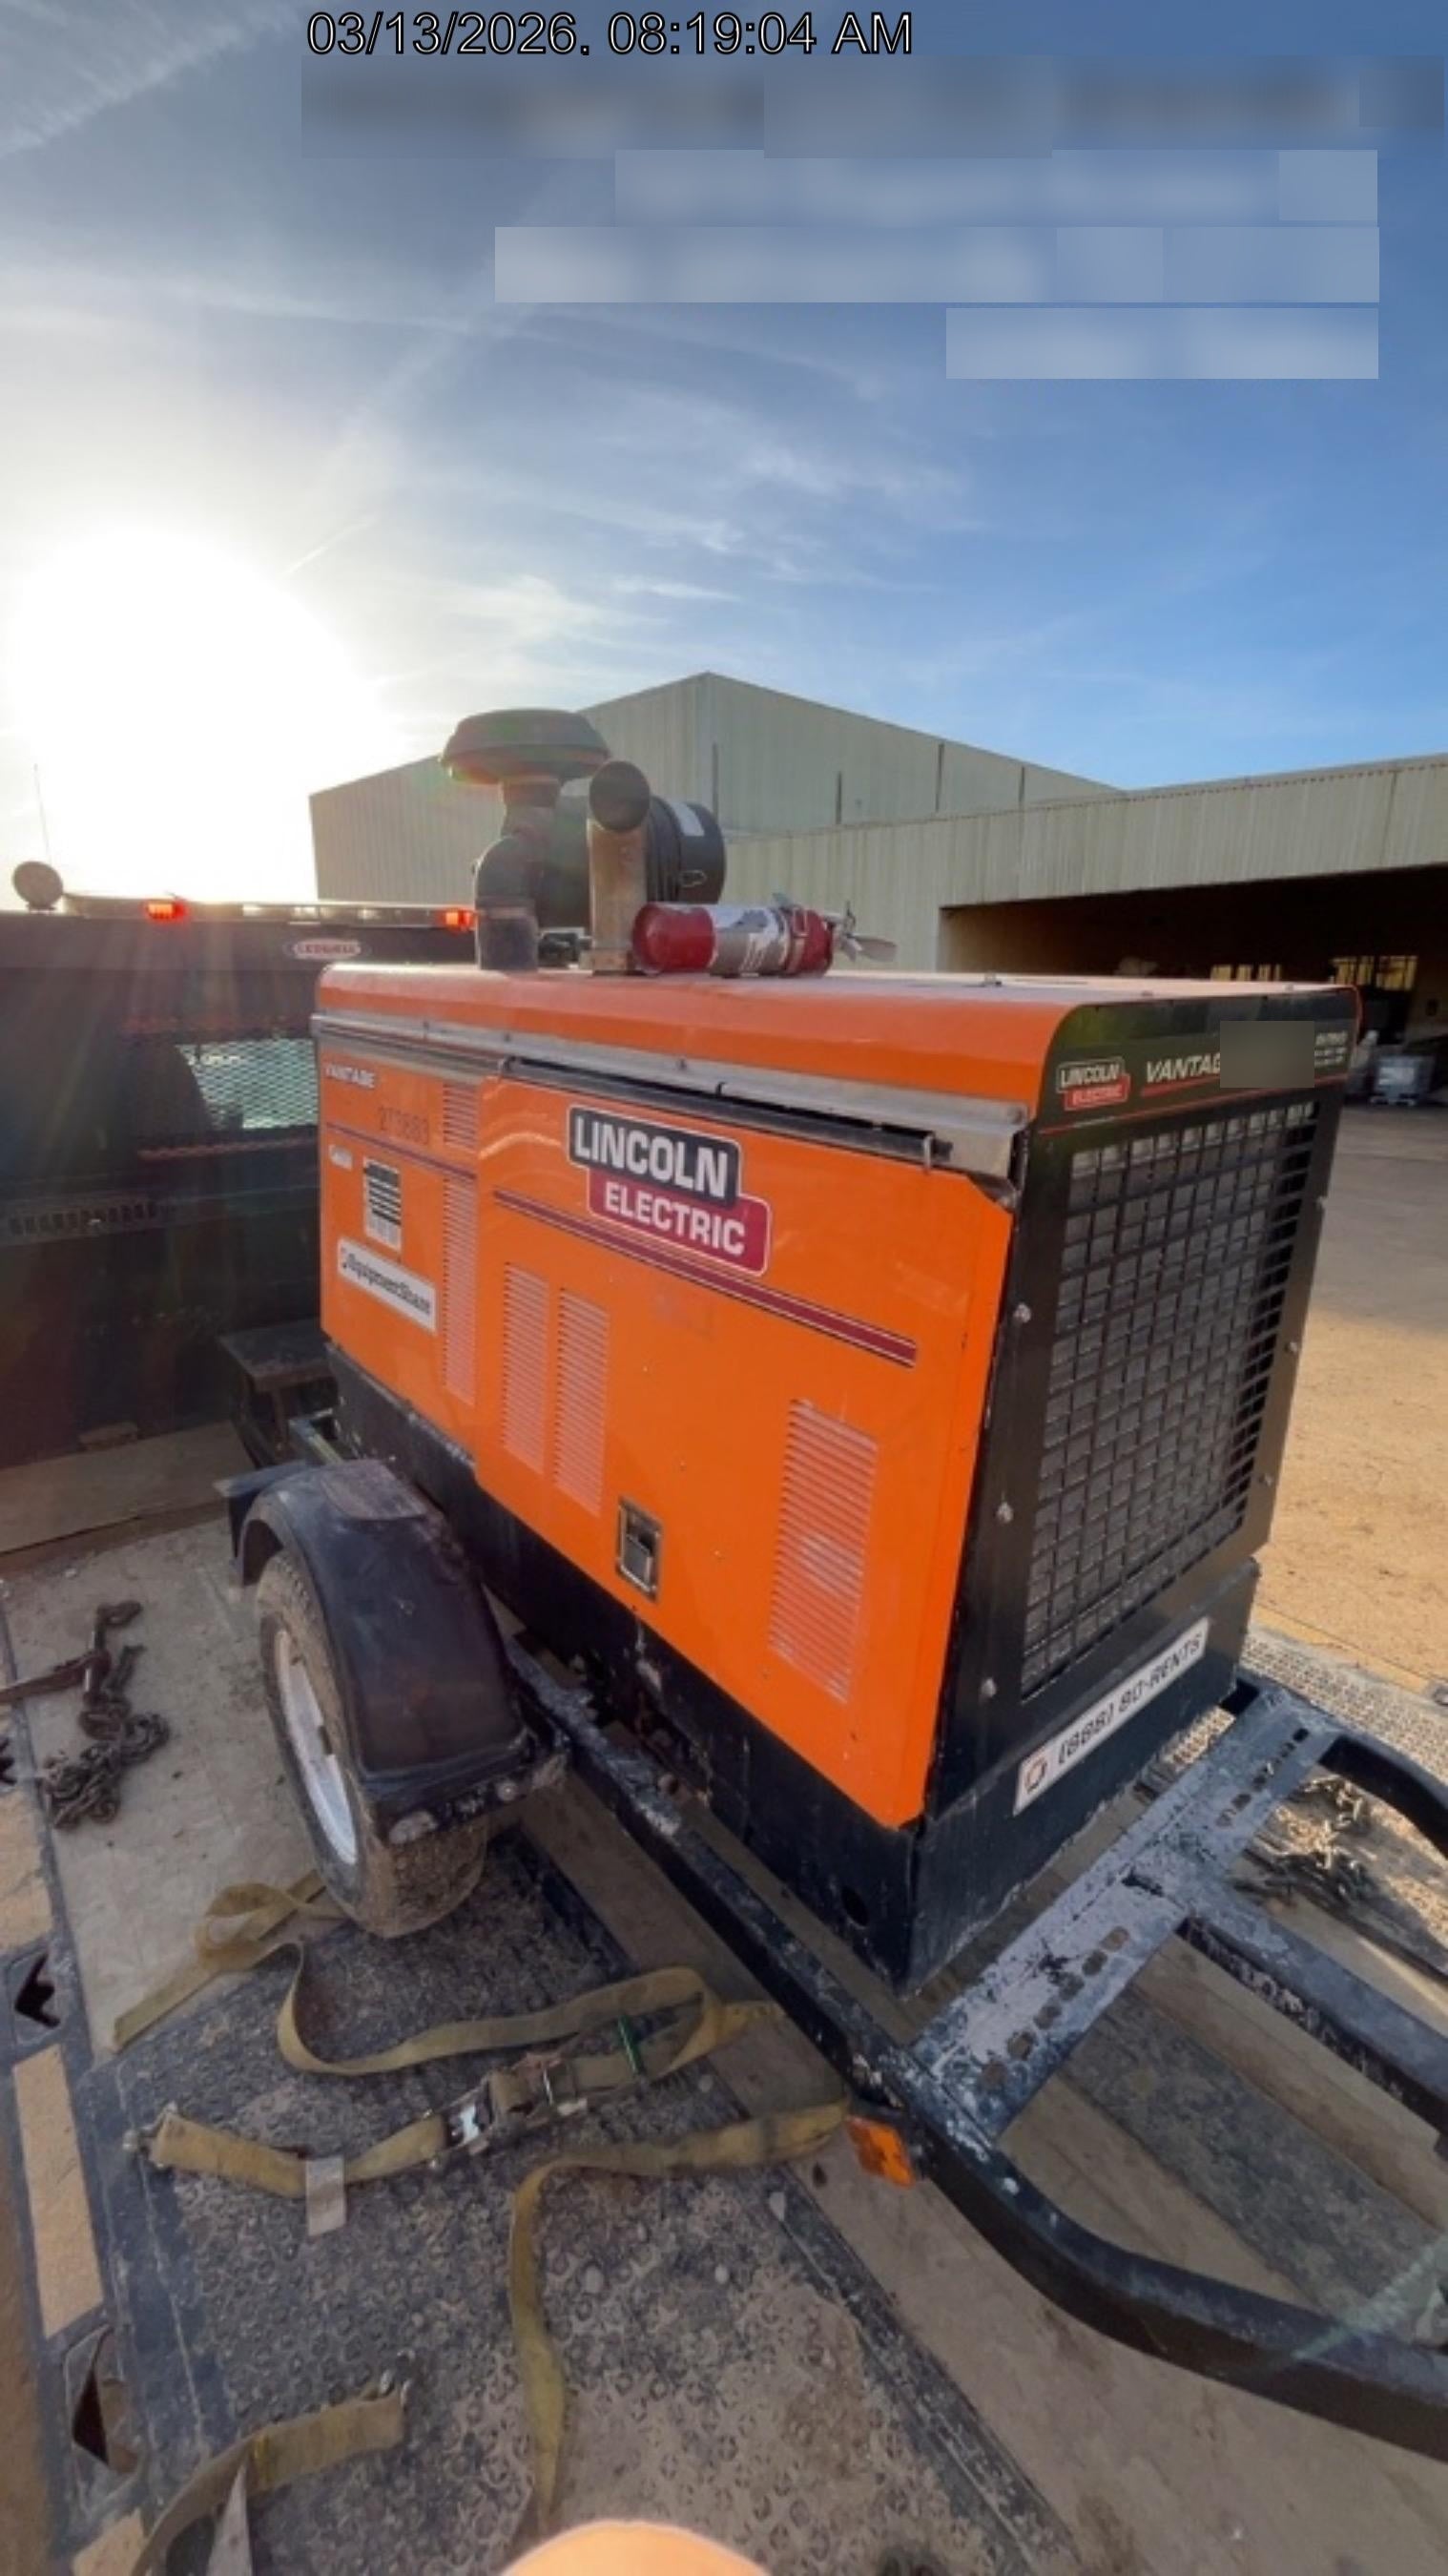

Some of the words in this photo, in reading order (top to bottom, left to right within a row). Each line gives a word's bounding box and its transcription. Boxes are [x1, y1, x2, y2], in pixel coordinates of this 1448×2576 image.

[1060, 1064, 1121, 1089] LINCOLN
[1147, 1053, 1221, 1083] VANTAG
[574, 1115, 729, 1198] LINCOLN
[604, 1180, 746, 1257] ELECTRIC
